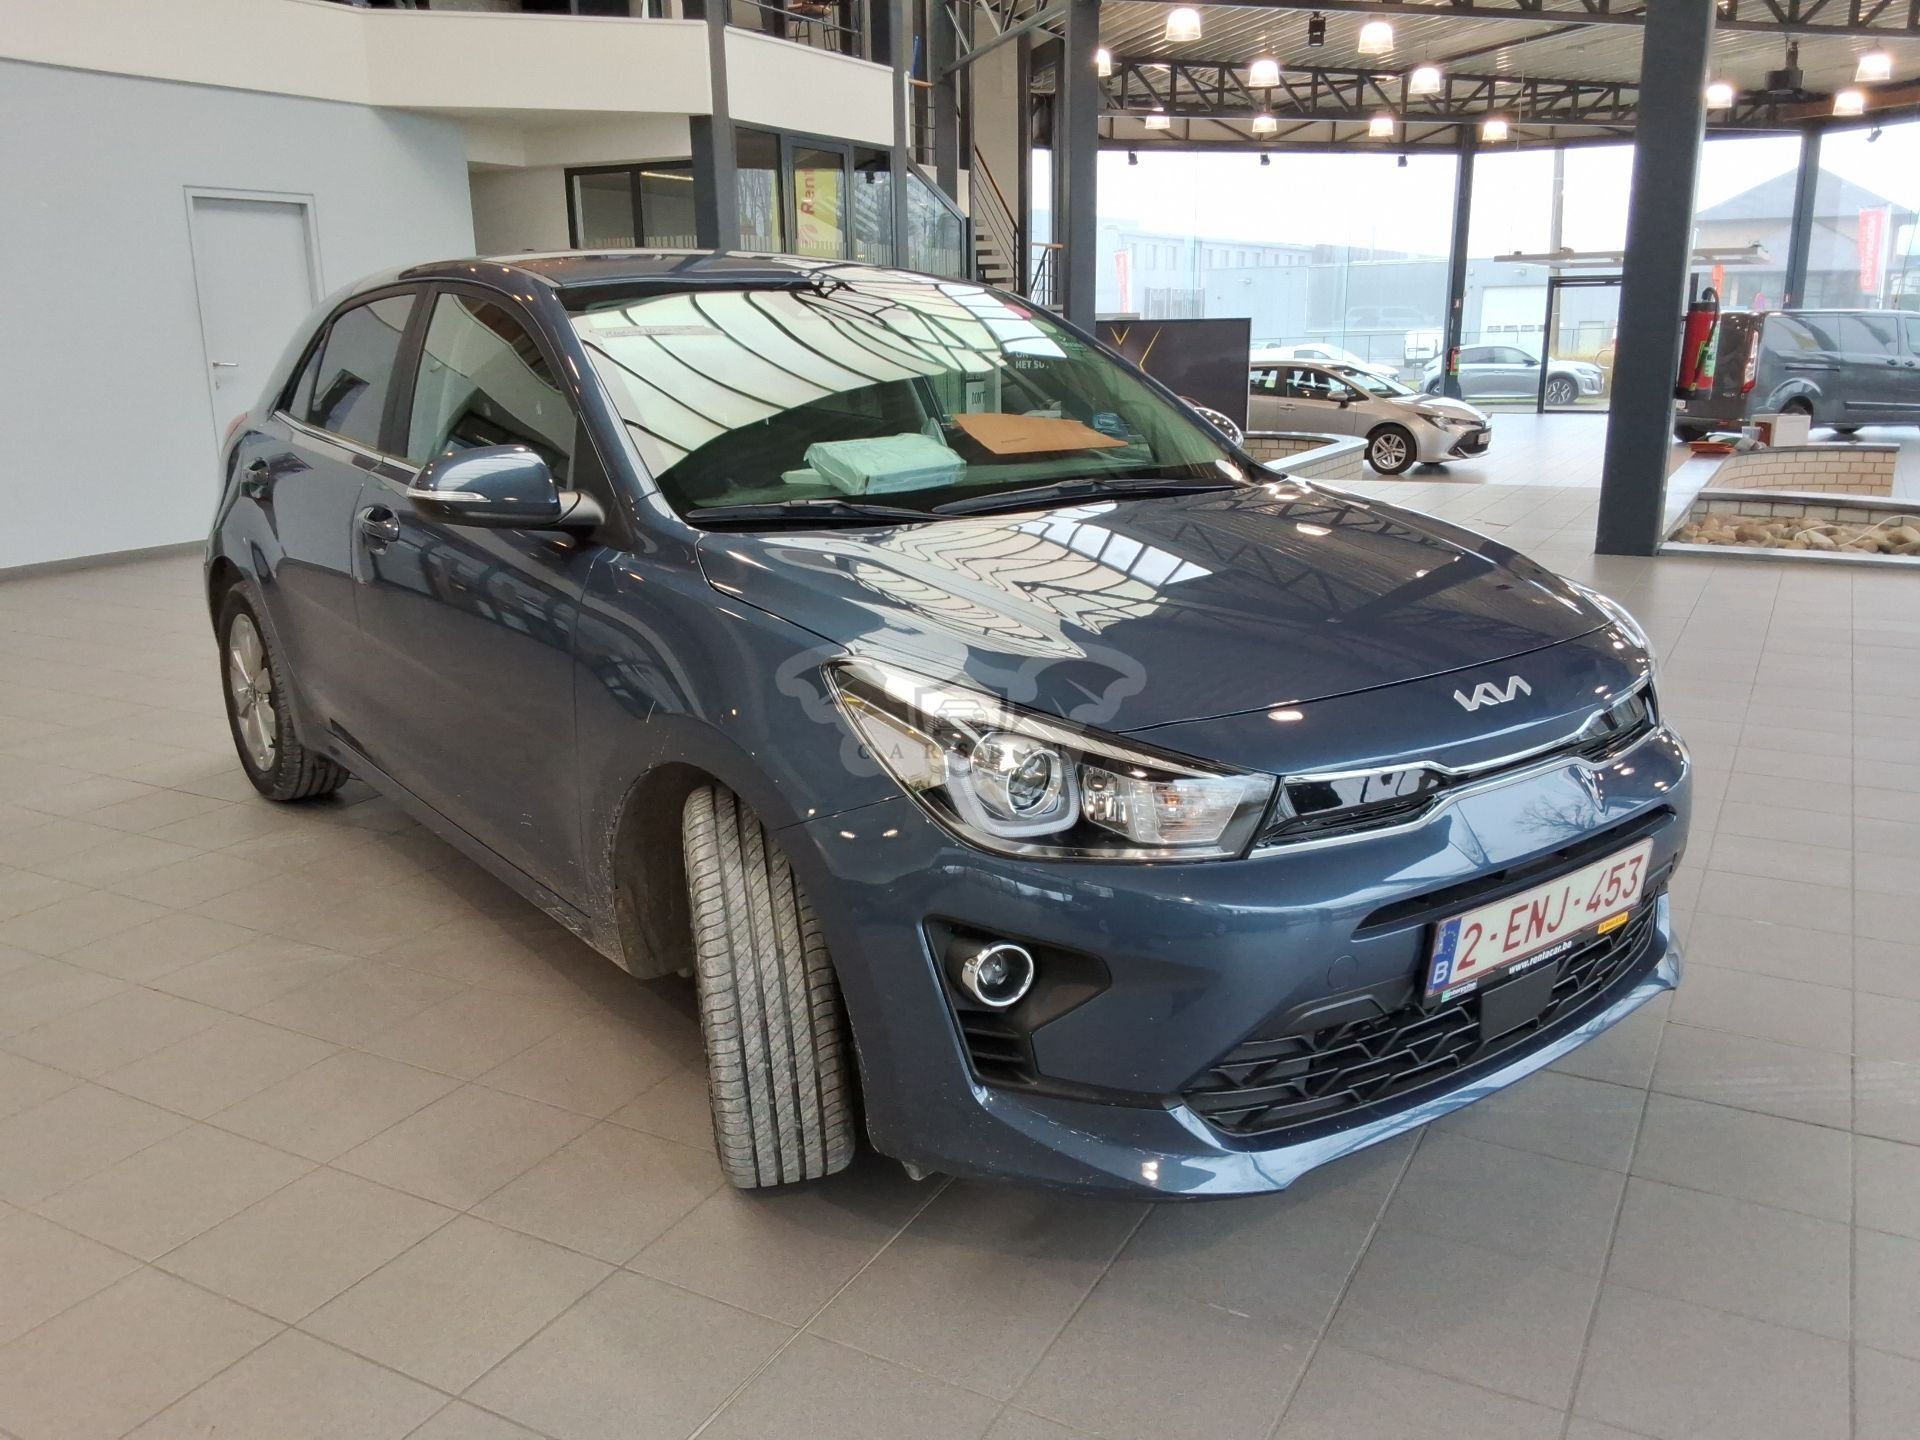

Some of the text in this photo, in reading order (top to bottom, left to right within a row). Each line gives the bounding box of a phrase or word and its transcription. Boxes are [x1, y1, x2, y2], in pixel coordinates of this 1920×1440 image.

[1016, 360, 1032, 369] HET
[1456, 854, 1644, 972] 2-ENJ-453
[1432, 960, 1449, 984] B
[1509, 940, 1572, 975] www.rentacar.be
